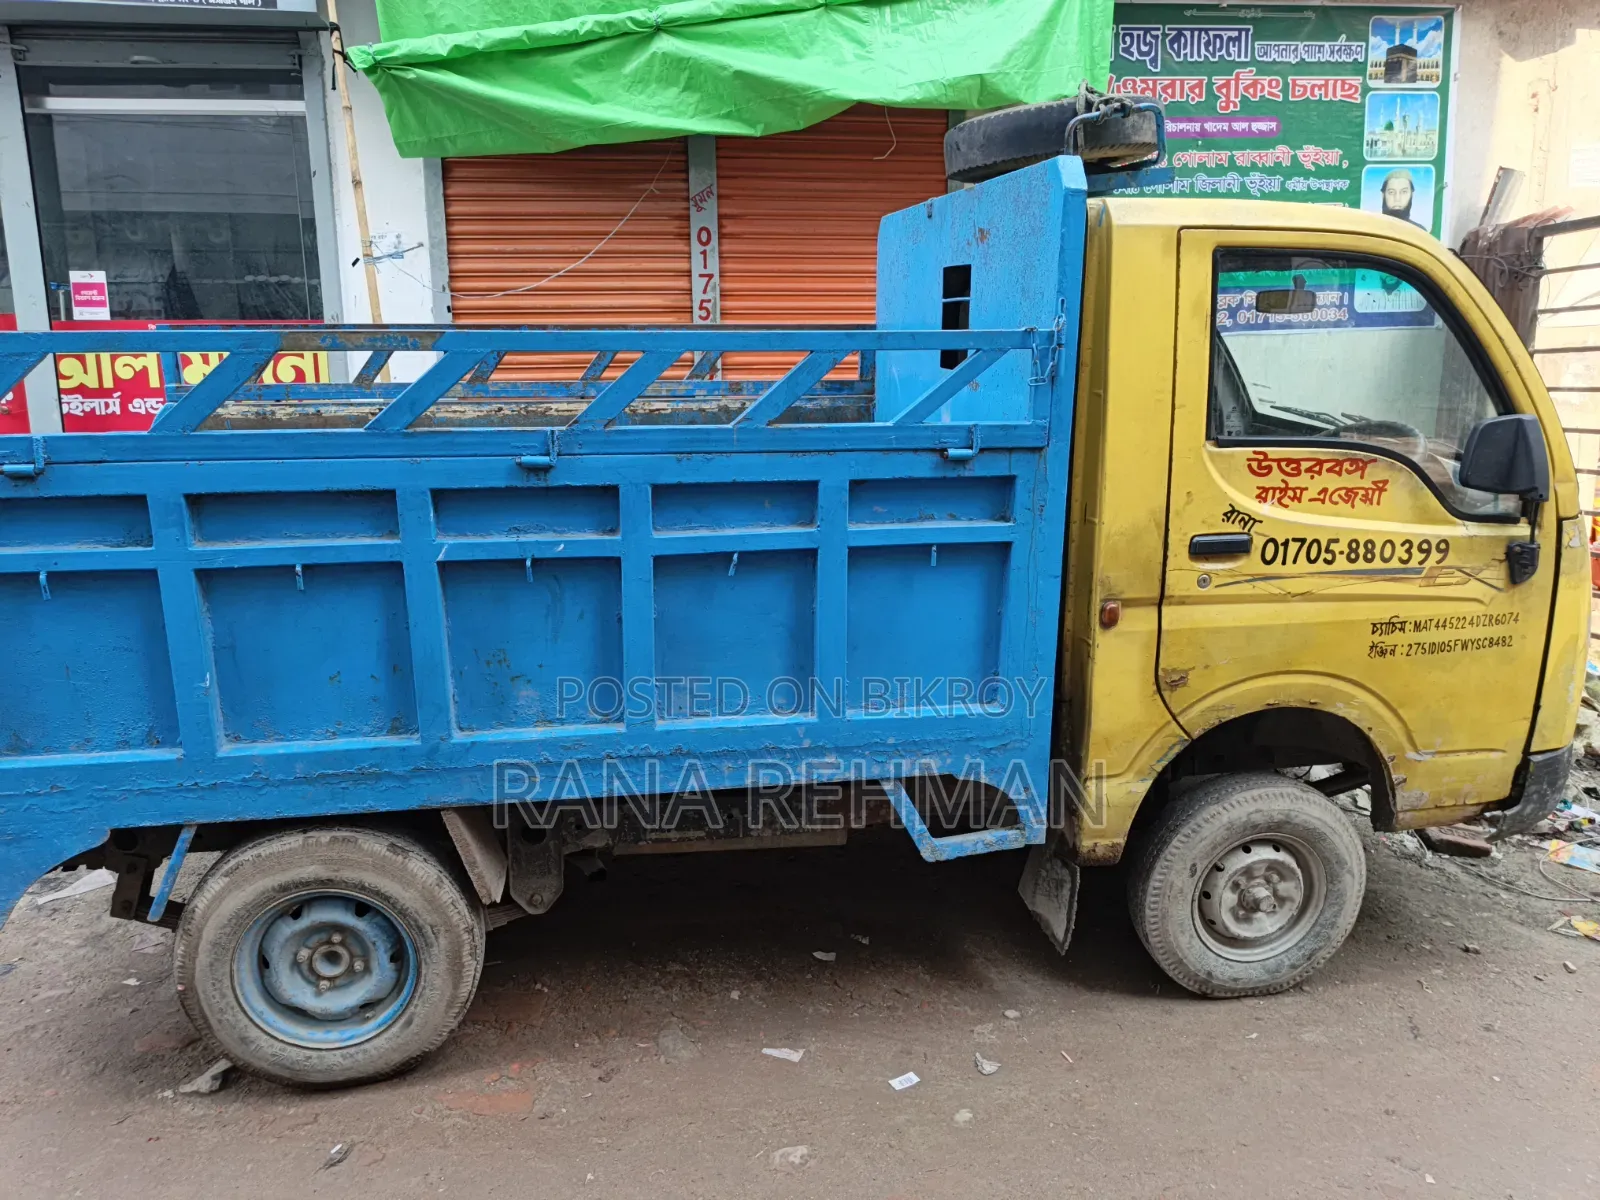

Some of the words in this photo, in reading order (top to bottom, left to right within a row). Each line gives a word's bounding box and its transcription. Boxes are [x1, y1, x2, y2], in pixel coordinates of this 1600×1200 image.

[1166, 25, 1253, 62] কাফেলা
[1255, 42, 1300, 64] আপনার
[1213, 68, 1282, 113] বুকিং
[1289, 76, 1363, 103] চলছে
[1164, 119, 1201, 133] রিচালনায়
[1231, 121, 1249, 132] আল
[1173, 148, 1231, 168] গোলাম
[1232, 145, 1294, 168] রাব্বানী
[1193, 172, 1242, 193] জিলানী
[58, 352, 161, 389] আল
[1245, 450, 1378, 480] উত্তরবঙ্গ
[1255, 478, 1309, 508] রাইস
[1221, 503, 1264, 533] রানা
[1260, 537, 1451, 567] 01705-880399
